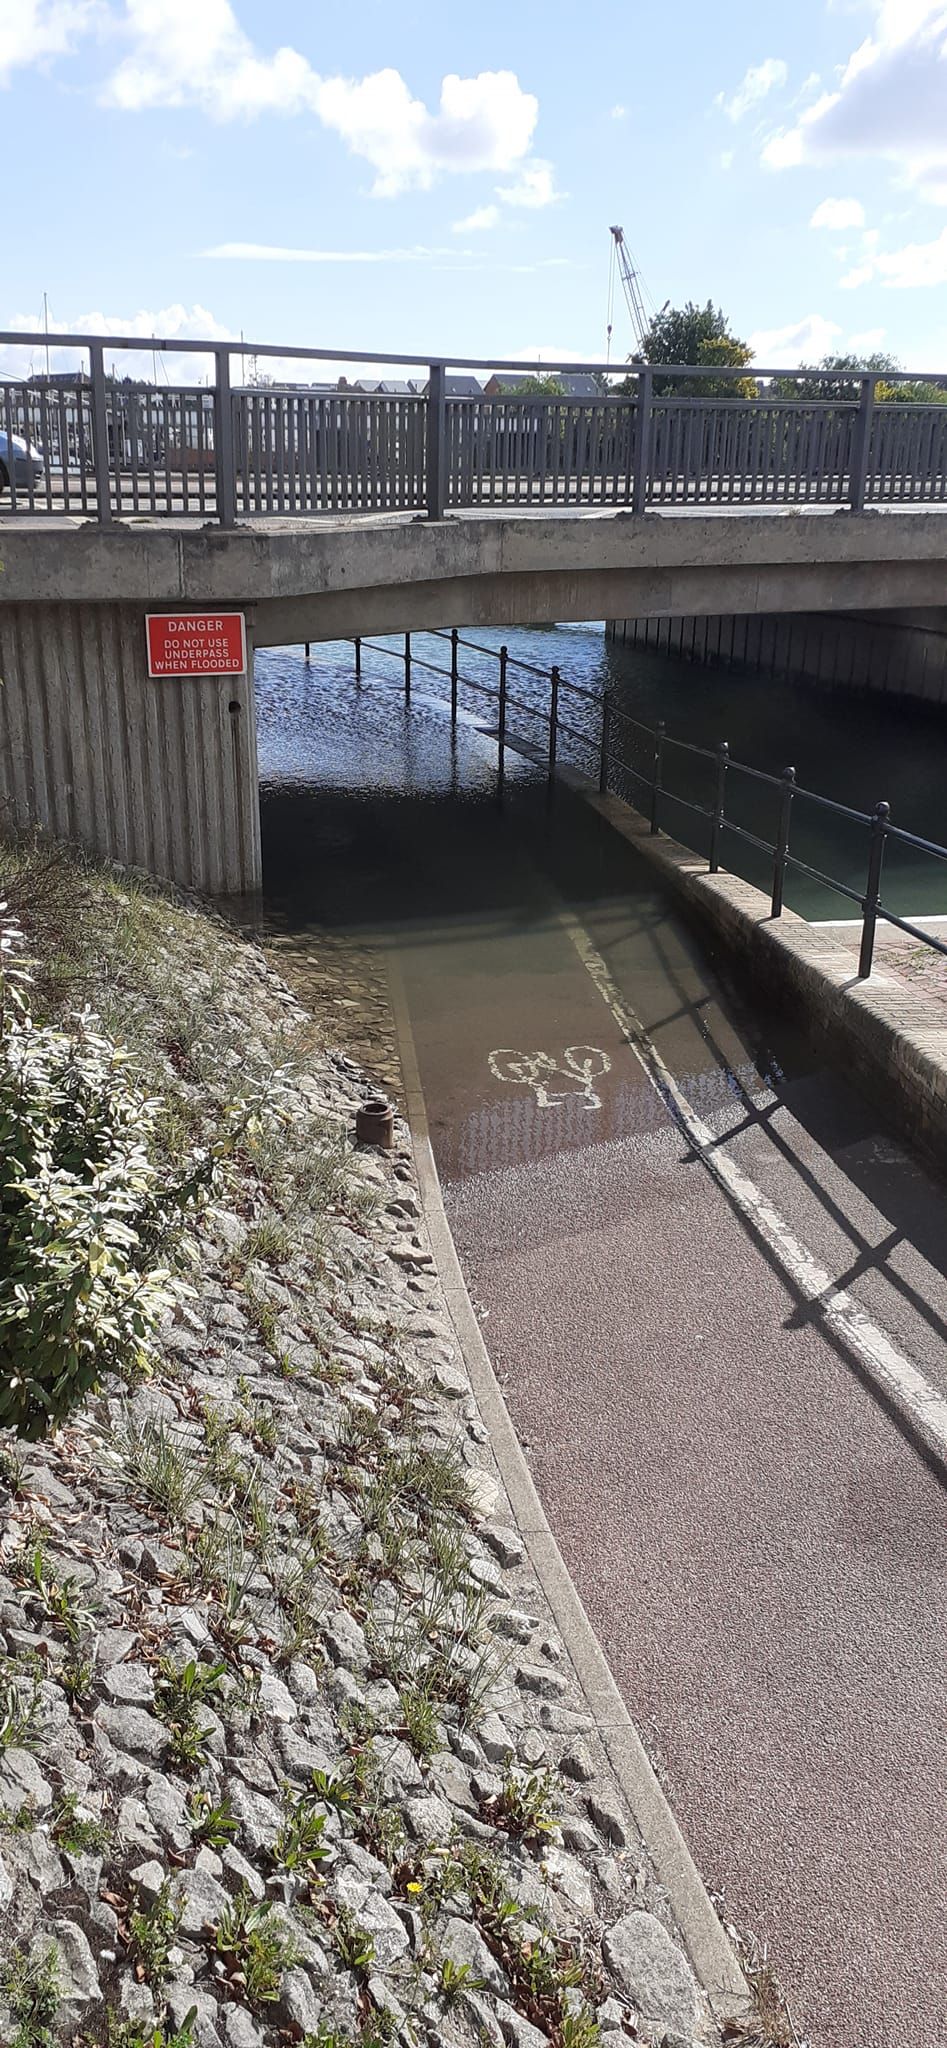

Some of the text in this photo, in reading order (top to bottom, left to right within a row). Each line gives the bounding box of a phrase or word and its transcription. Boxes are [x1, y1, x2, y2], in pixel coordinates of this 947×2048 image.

[168, 620, 223, 632] DANGER
[164, 638, 229, 649] DO NOT USE
[165, 648, 229, 660] UNDERPASS
[155, 658, 239, 670] WHEN FLOODED
